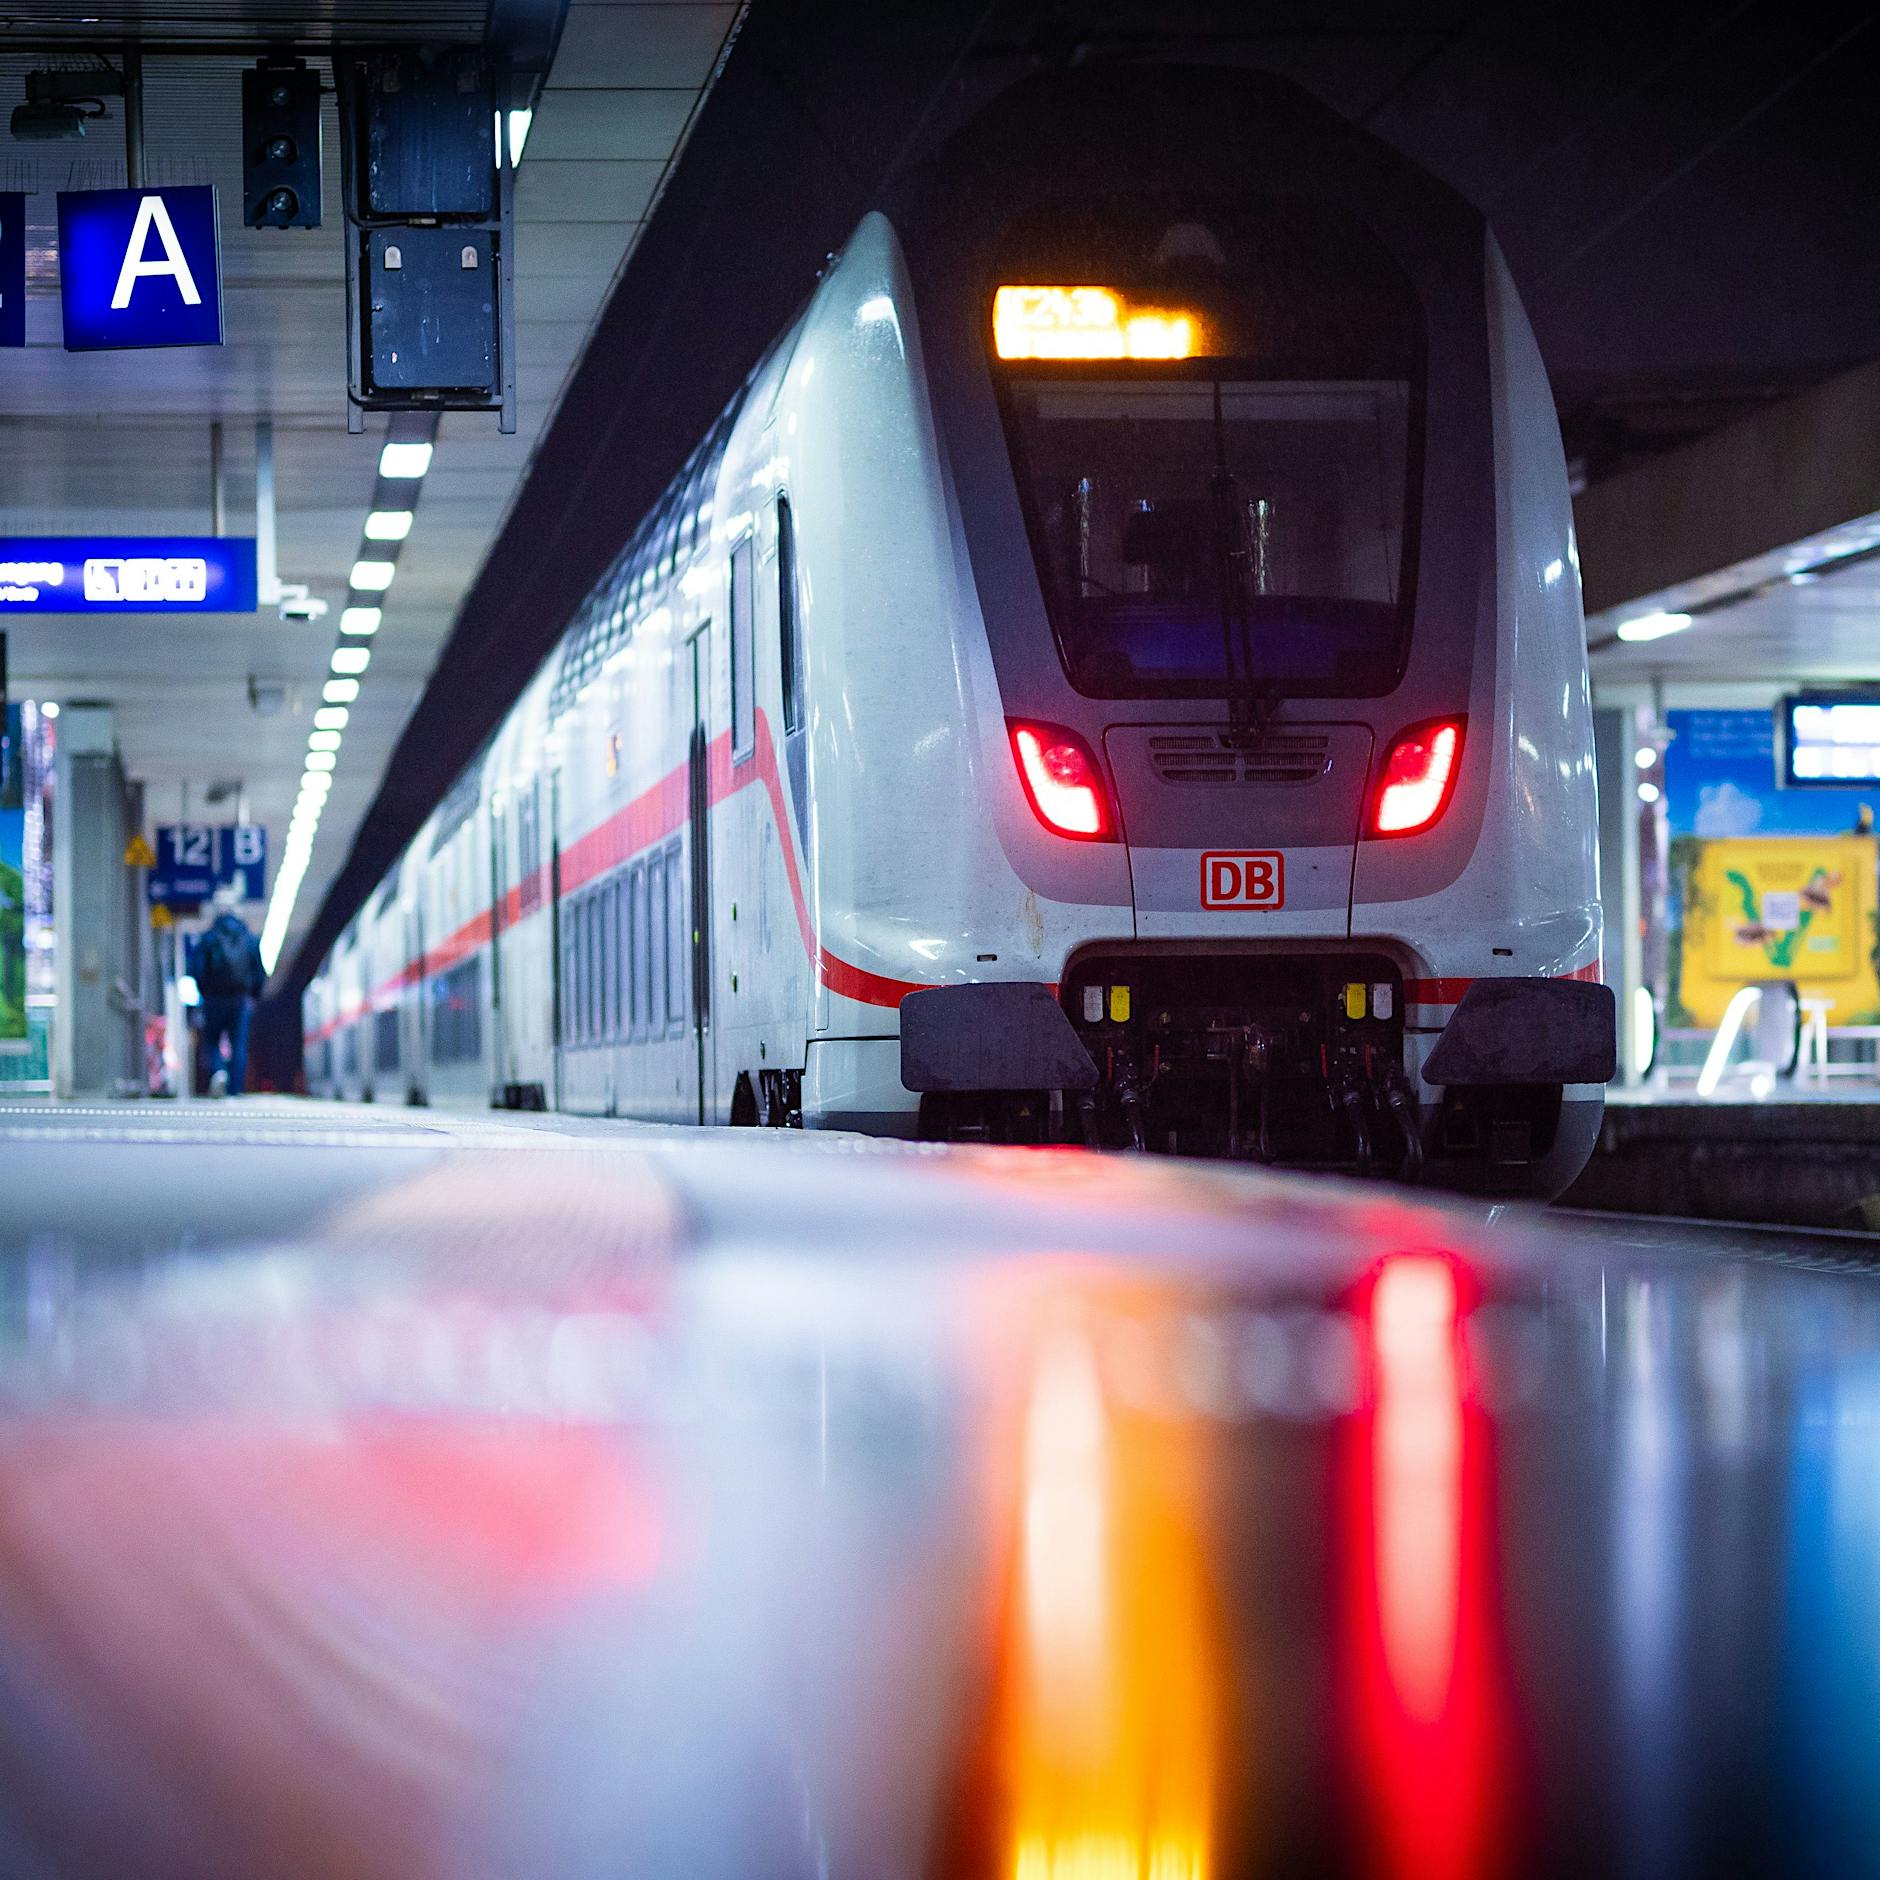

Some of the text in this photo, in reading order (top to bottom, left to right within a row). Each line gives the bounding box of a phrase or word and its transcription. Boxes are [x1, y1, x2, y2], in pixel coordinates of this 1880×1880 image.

[110, 195, 202, 310] A
[167, 828, 210, 866] 12
[234, 826, 263, 866] B
[1210, 859, 1276, 902] DB
